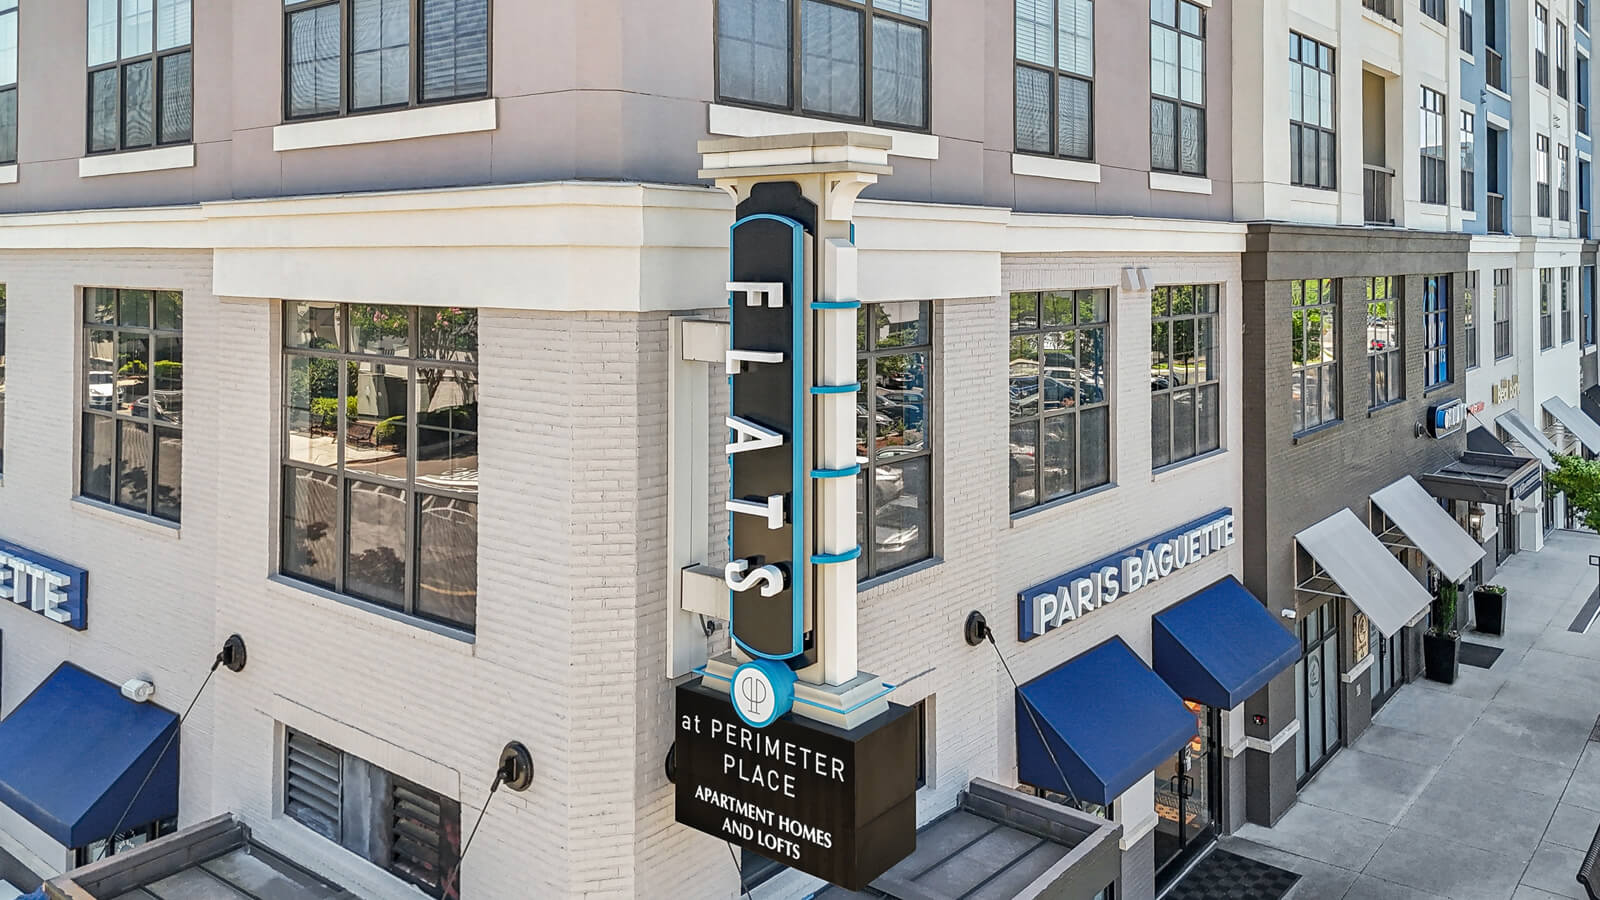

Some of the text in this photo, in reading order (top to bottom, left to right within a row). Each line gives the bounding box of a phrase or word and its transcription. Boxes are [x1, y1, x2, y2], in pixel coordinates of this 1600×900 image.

[725, 281, 785, 598] FLATS
[1033, 514, 1236, 636] PARIS BAGUETTE
[681, 713, 846, 783] at PERIMETER
[723, 753, 796, 799] PLACE
[694, 784, 833, 849] APARTMENT HOMES
[721, 817, 801, 861] AND LOFTS
